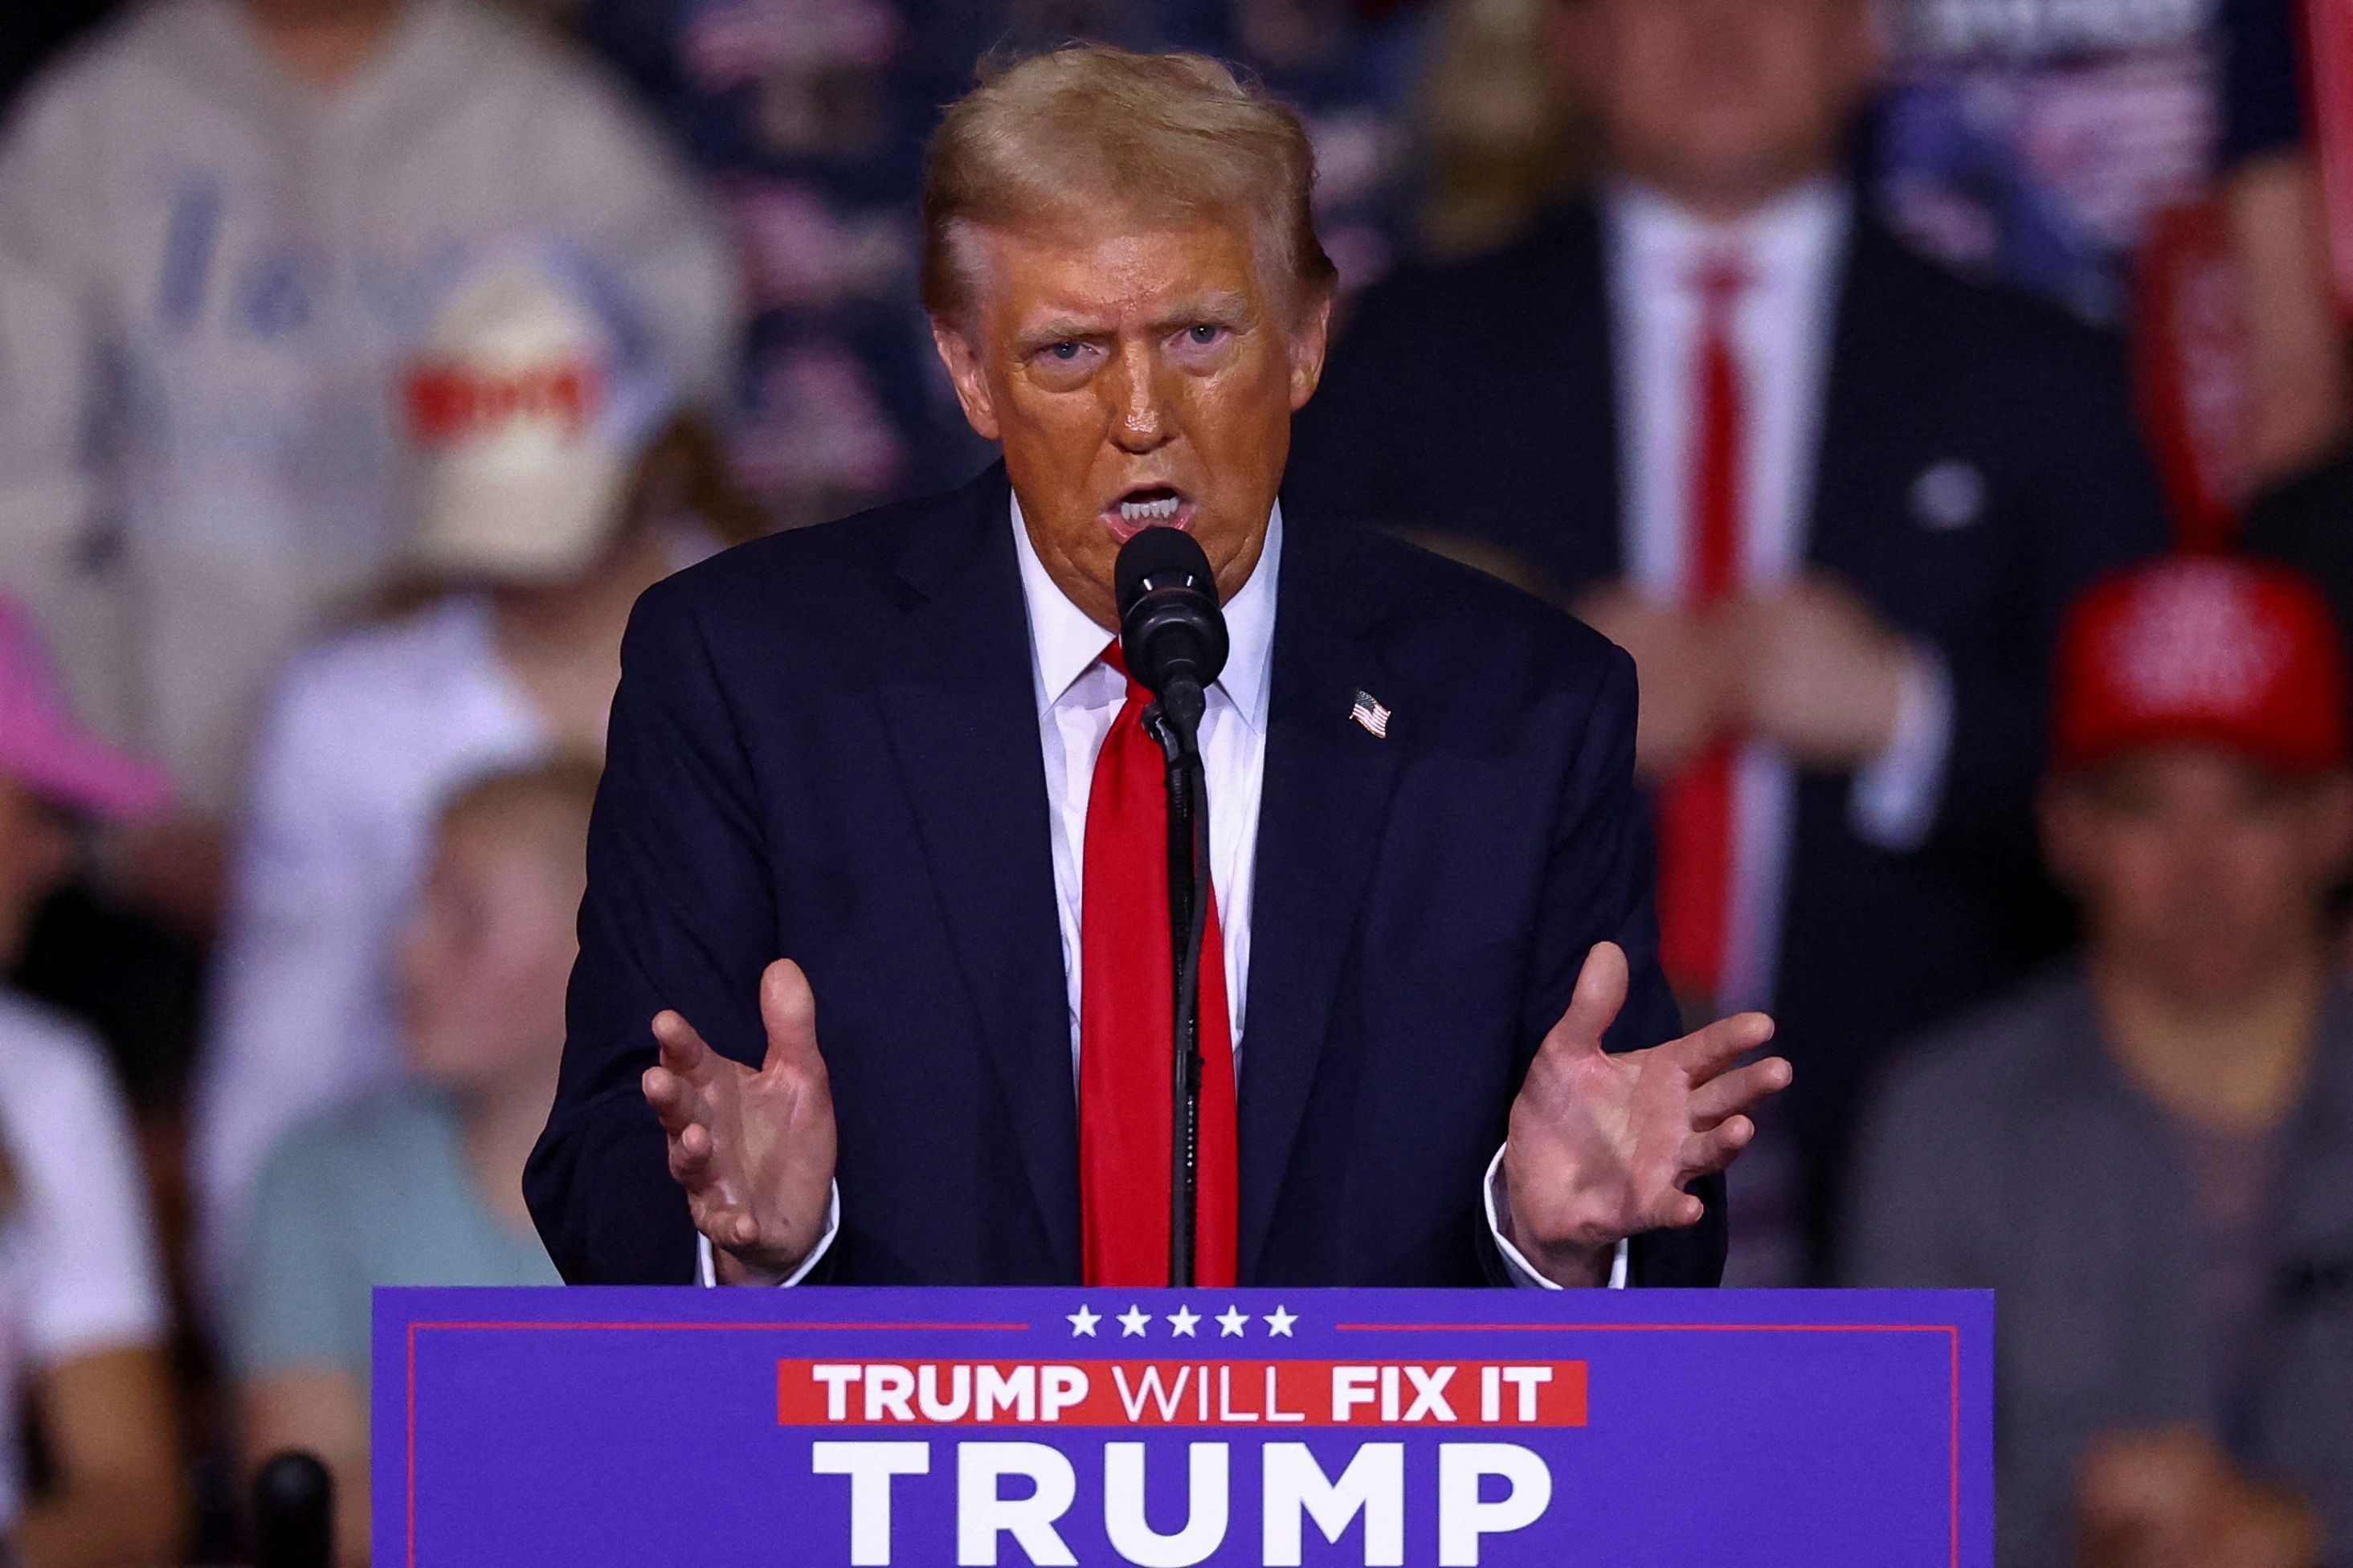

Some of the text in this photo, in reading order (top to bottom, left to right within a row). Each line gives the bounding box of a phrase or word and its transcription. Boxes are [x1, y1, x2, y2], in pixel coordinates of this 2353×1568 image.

[812, 1364, 1553, 1422] TRUMP WILL FIX IT
[811, 1440, 1553, 1568] TRUMP
